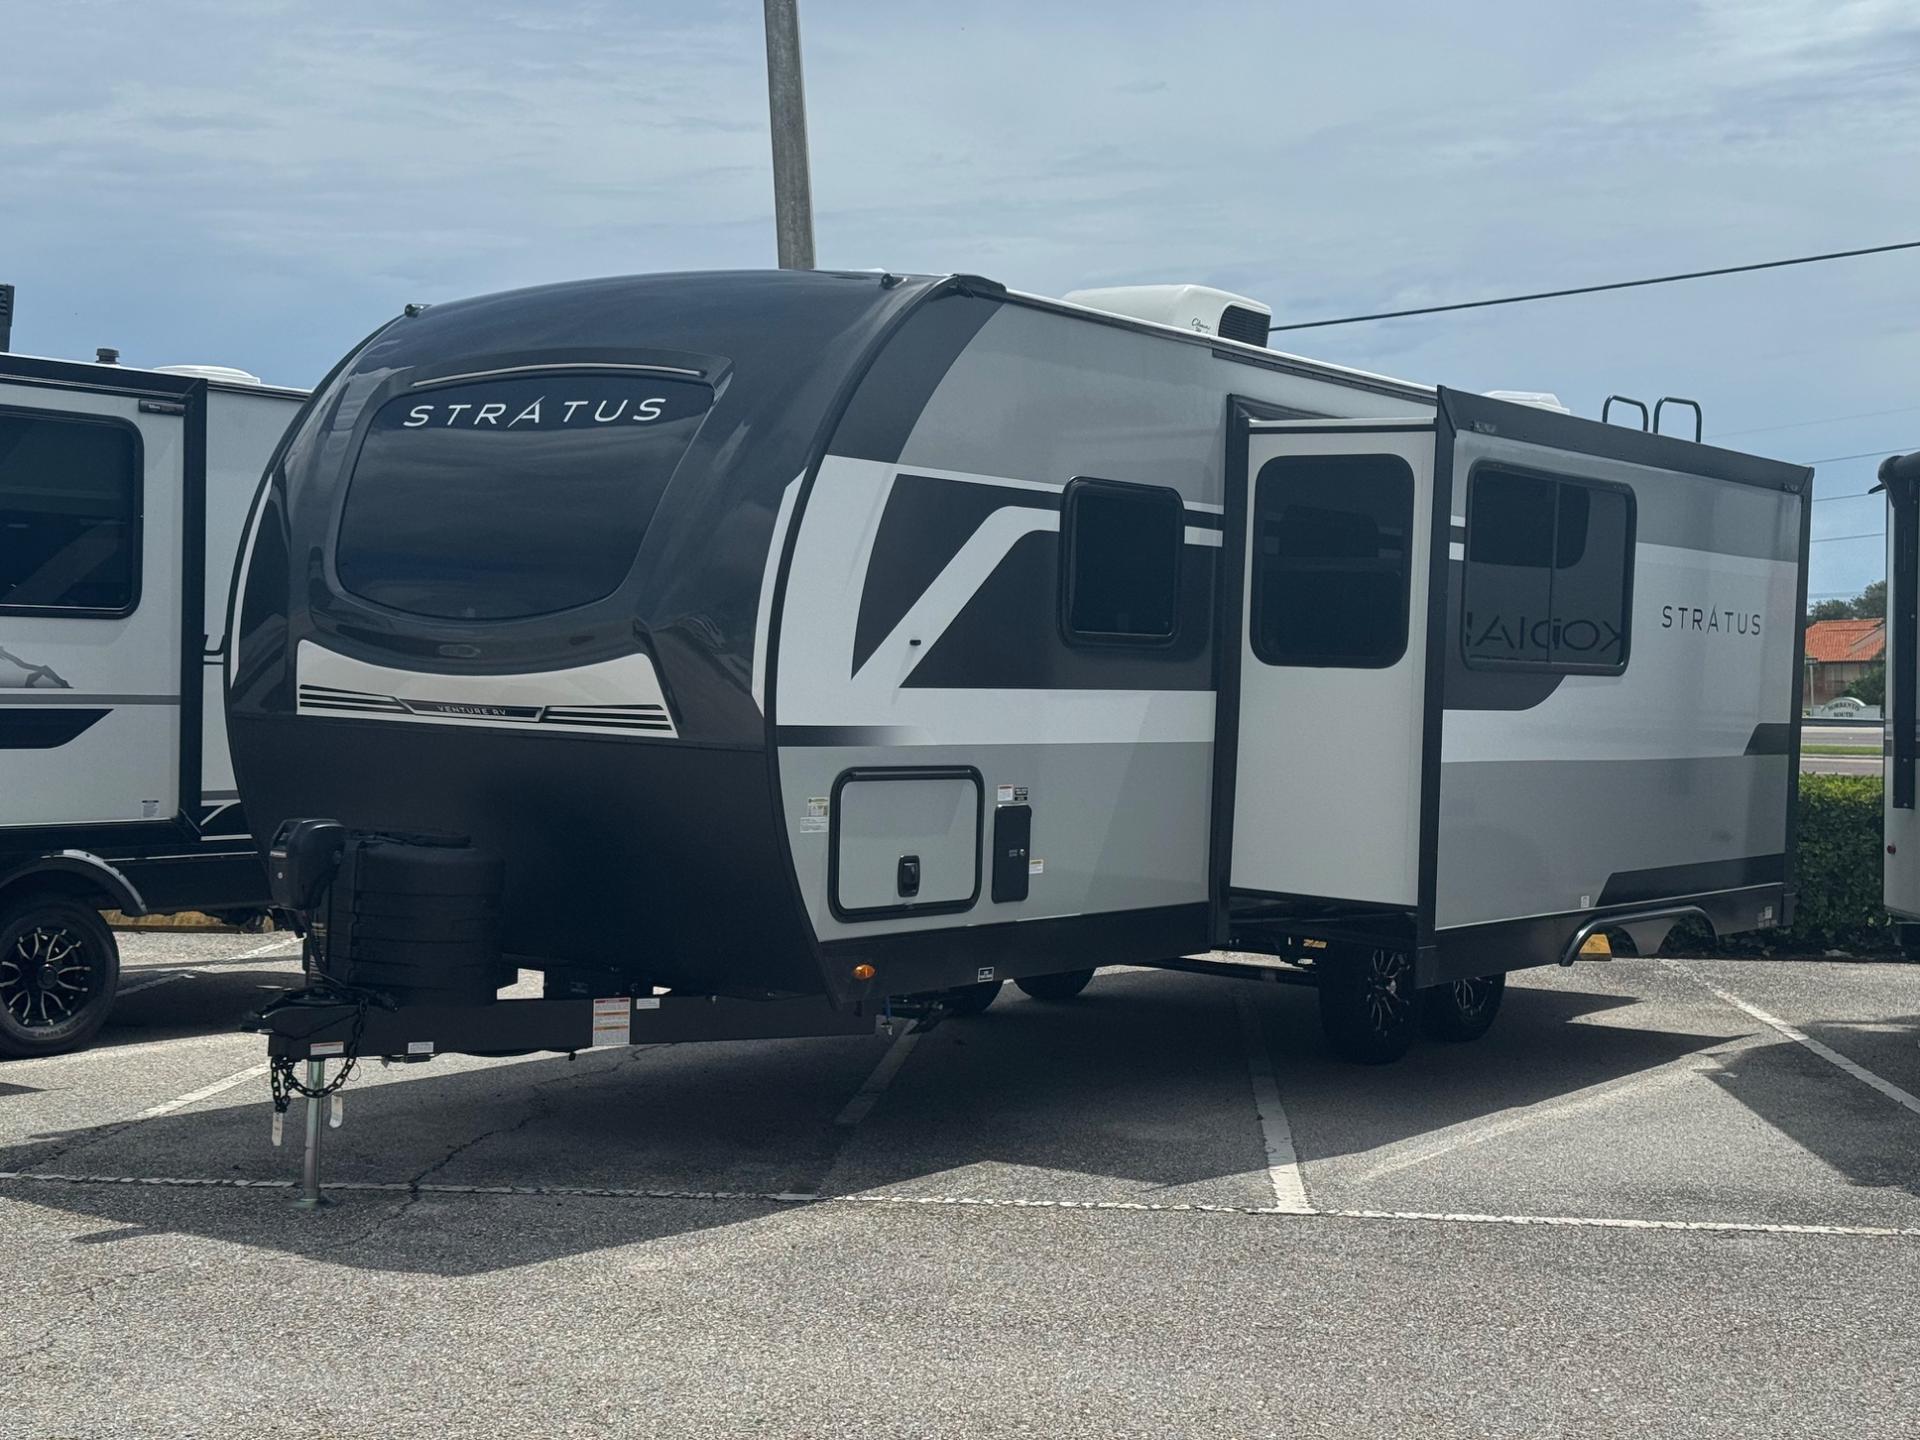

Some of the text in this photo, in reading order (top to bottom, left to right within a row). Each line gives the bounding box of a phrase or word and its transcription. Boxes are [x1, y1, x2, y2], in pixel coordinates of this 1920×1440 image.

[403, 395, 667, 428] STRATUS
[1661, 603, 1761, 635] STRATUS
[436, 704, 506, 716] VENTURE RV
